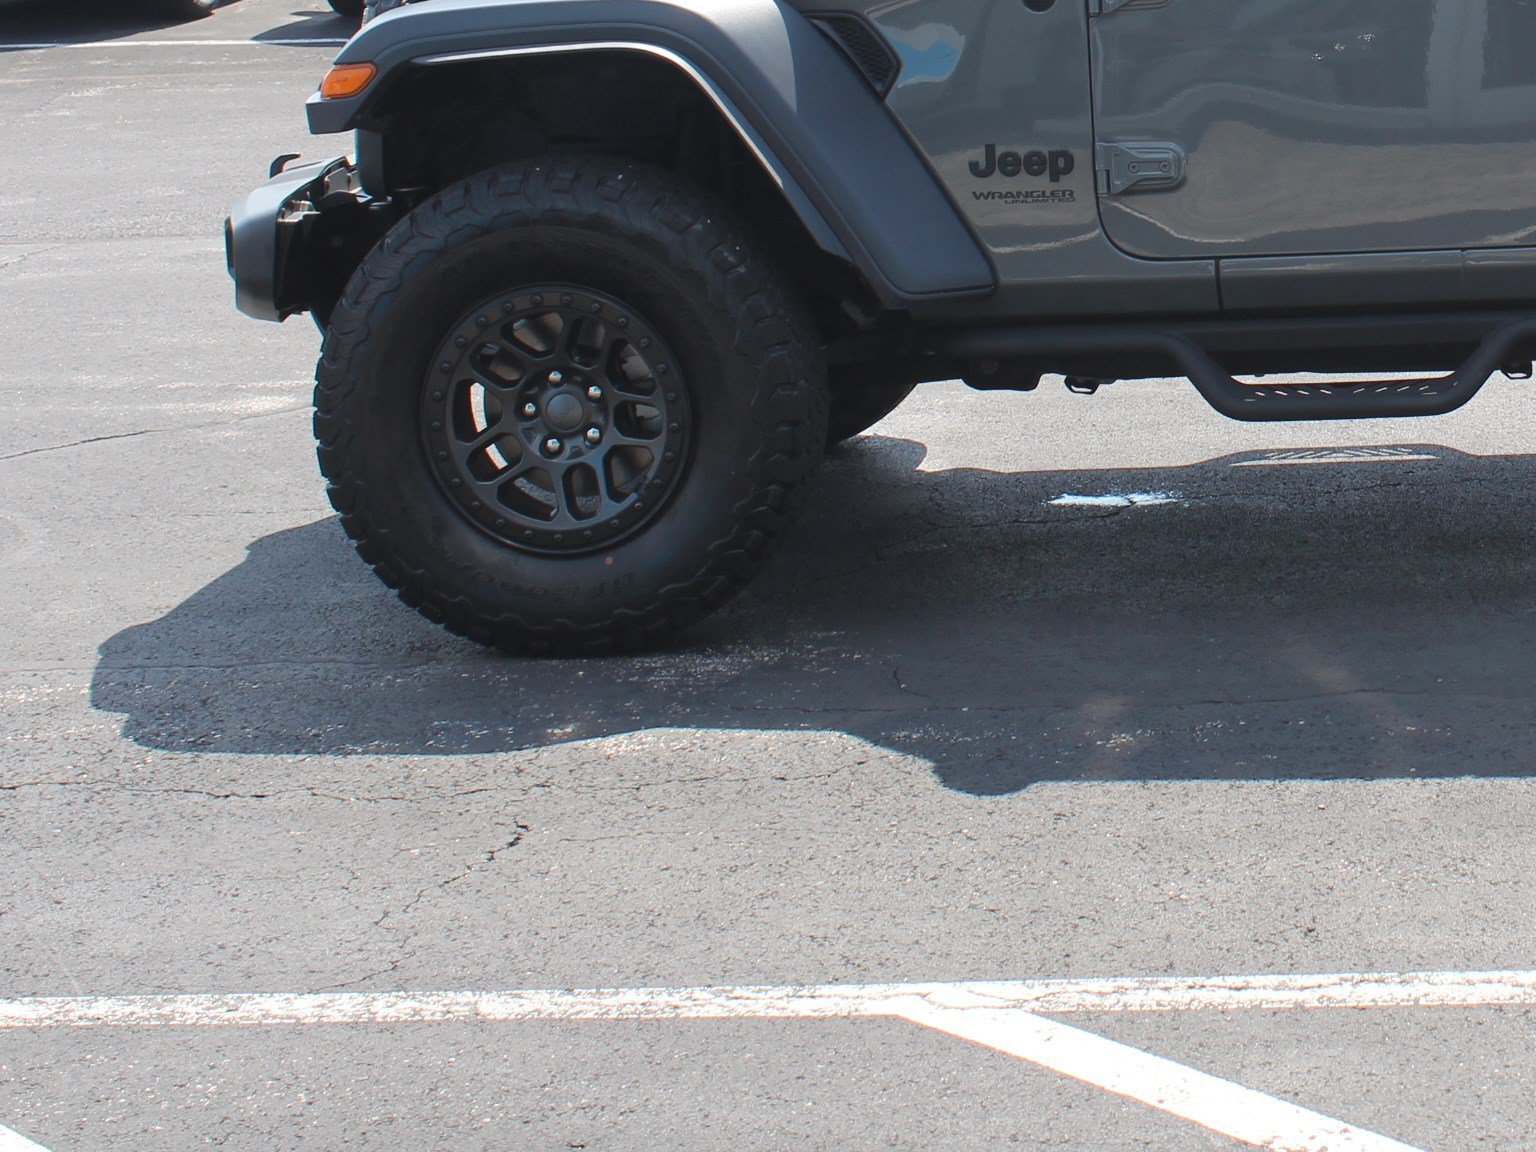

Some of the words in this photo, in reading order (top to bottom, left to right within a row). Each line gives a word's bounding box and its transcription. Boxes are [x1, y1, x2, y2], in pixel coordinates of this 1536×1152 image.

[968, 143, 1075, 183] Jeep
[971, 189, 1075, 201] WRANGLER
[1004, 197, 1076, 205] UNLIMITED
